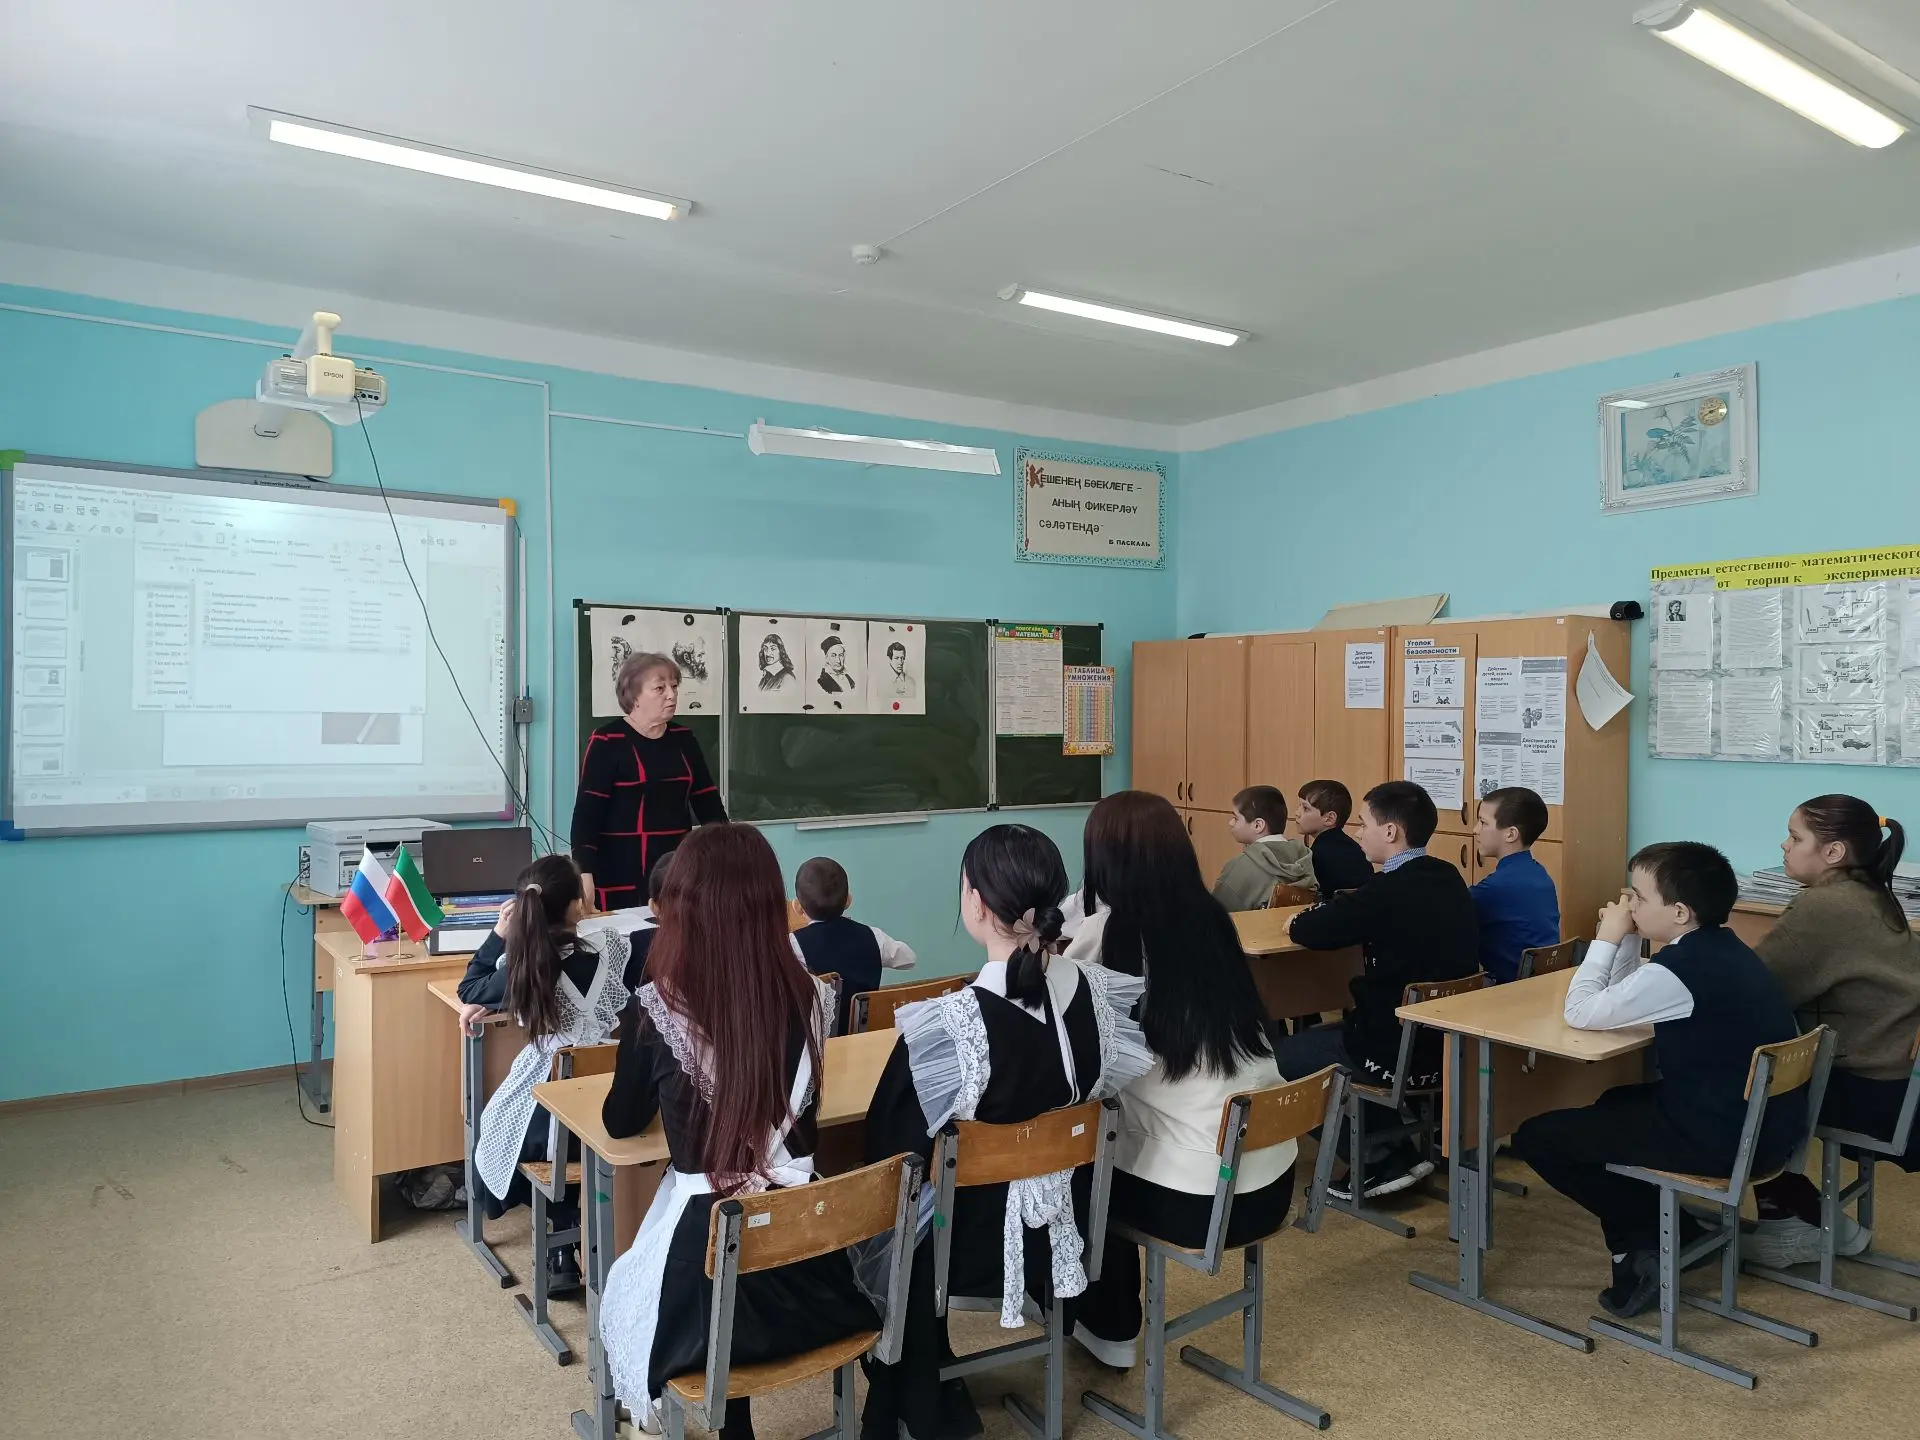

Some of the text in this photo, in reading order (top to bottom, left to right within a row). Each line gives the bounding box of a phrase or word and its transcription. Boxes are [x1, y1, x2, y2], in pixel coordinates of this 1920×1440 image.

[323, 371, 344, 379] EPSON
[1028, 463, 1082, 490] КЕШЕНЕҢ
[1084, 478, 1134, 492] БӨЕКЛЕГЕ
[1051, 498, 1081, 511] АНЫҢ
[1116, 539, 1151, 547] ПАСКАЛЬ
[1651, 567, 1710, 580] Предметы
[1715, 560, 1797, 574] естественно-
[1717, 580, 1731, 589] от
[1745, 576, 1789, 588] теории
[1793, 575, 1802, 583] к
[1407, 640, 1432, 648] Уголок
